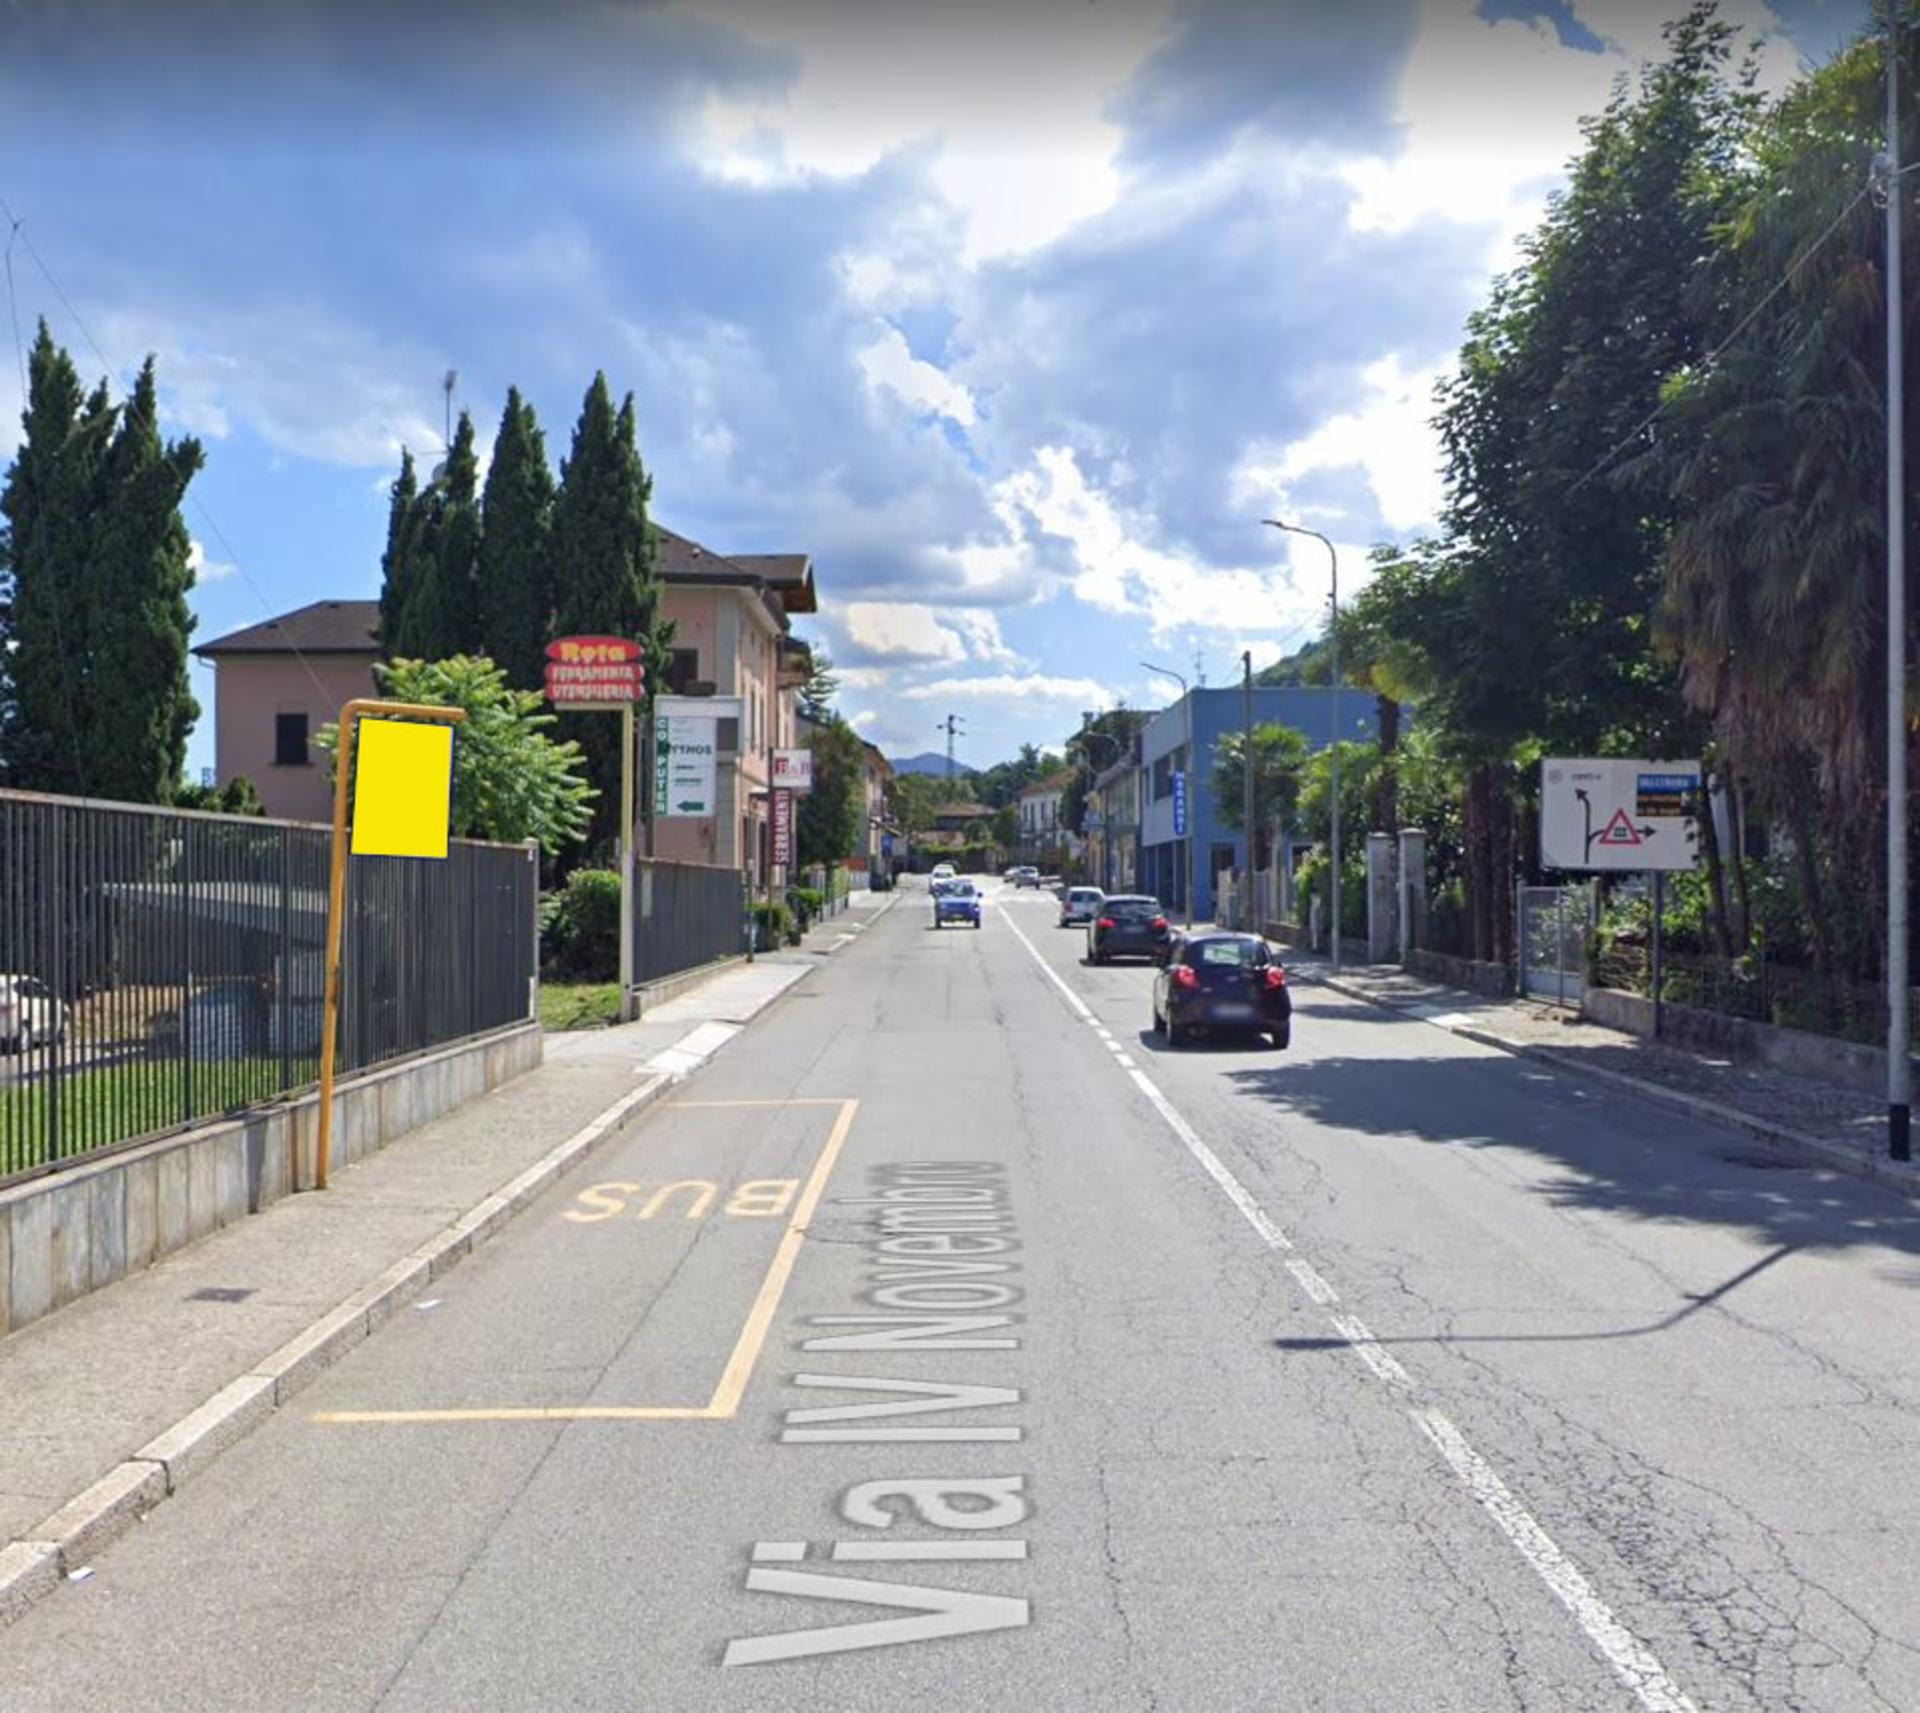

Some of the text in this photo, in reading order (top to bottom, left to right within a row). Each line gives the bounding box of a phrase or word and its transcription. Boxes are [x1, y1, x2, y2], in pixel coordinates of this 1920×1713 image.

[560, 642, 627, 662] Rota
[774, 790, 789, 863] SERRAMENTI
[560, 1179, 799, 1223] BUS
